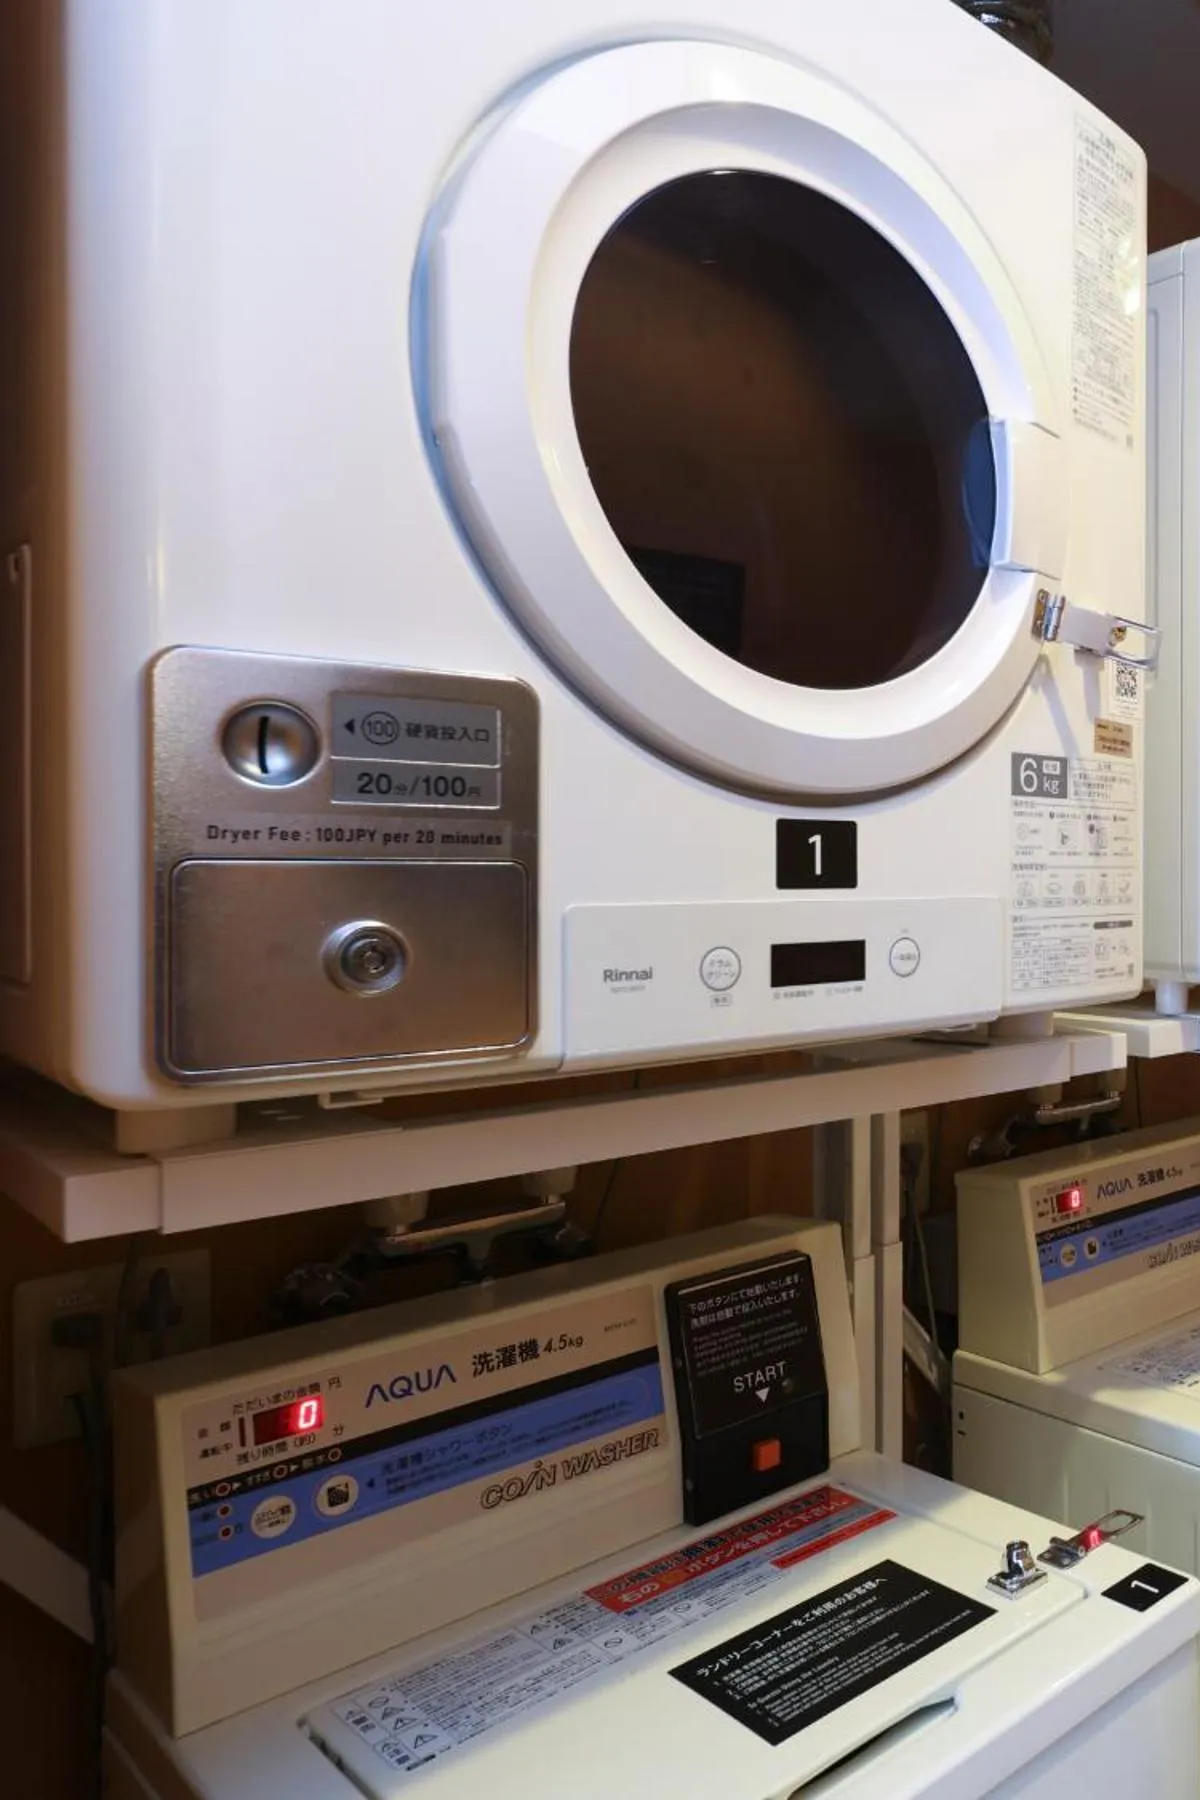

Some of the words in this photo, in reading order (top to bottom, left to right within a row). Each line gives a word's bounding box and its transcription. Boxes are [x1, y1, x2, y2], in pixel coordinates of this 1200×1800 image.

[1019, 757, 1038, 793] 6
[1042, 778, 1060, 795] kg
[206, 825, 259, 844] Dryer
[315, 828, 378, 844] 100JPY
[382, 832, 410, 847] per
[415, 831, 435, 844] 20
[440, 833, 503, 846] minutes
[807, 833, 823, 876] 1
[602, 966, 653, 983] Rinnai
[364, 1364, 457, 1408] AQUA
[470, 1337, 541, 1377] 洗濯機
[542, 1333, 584, 1356] 4.5kg
[732, 1361, 788, 1394] START
[297, 1398, 319, 1430] 0
[479, 1459, 558, 1510] COIN
[561, 1427, 662, 1480] WASHER
[1130, 1579, 1160, 1595] 1
[696, 1577, 889, 1677] ランドリーコーナーをご利用のお客様へ
